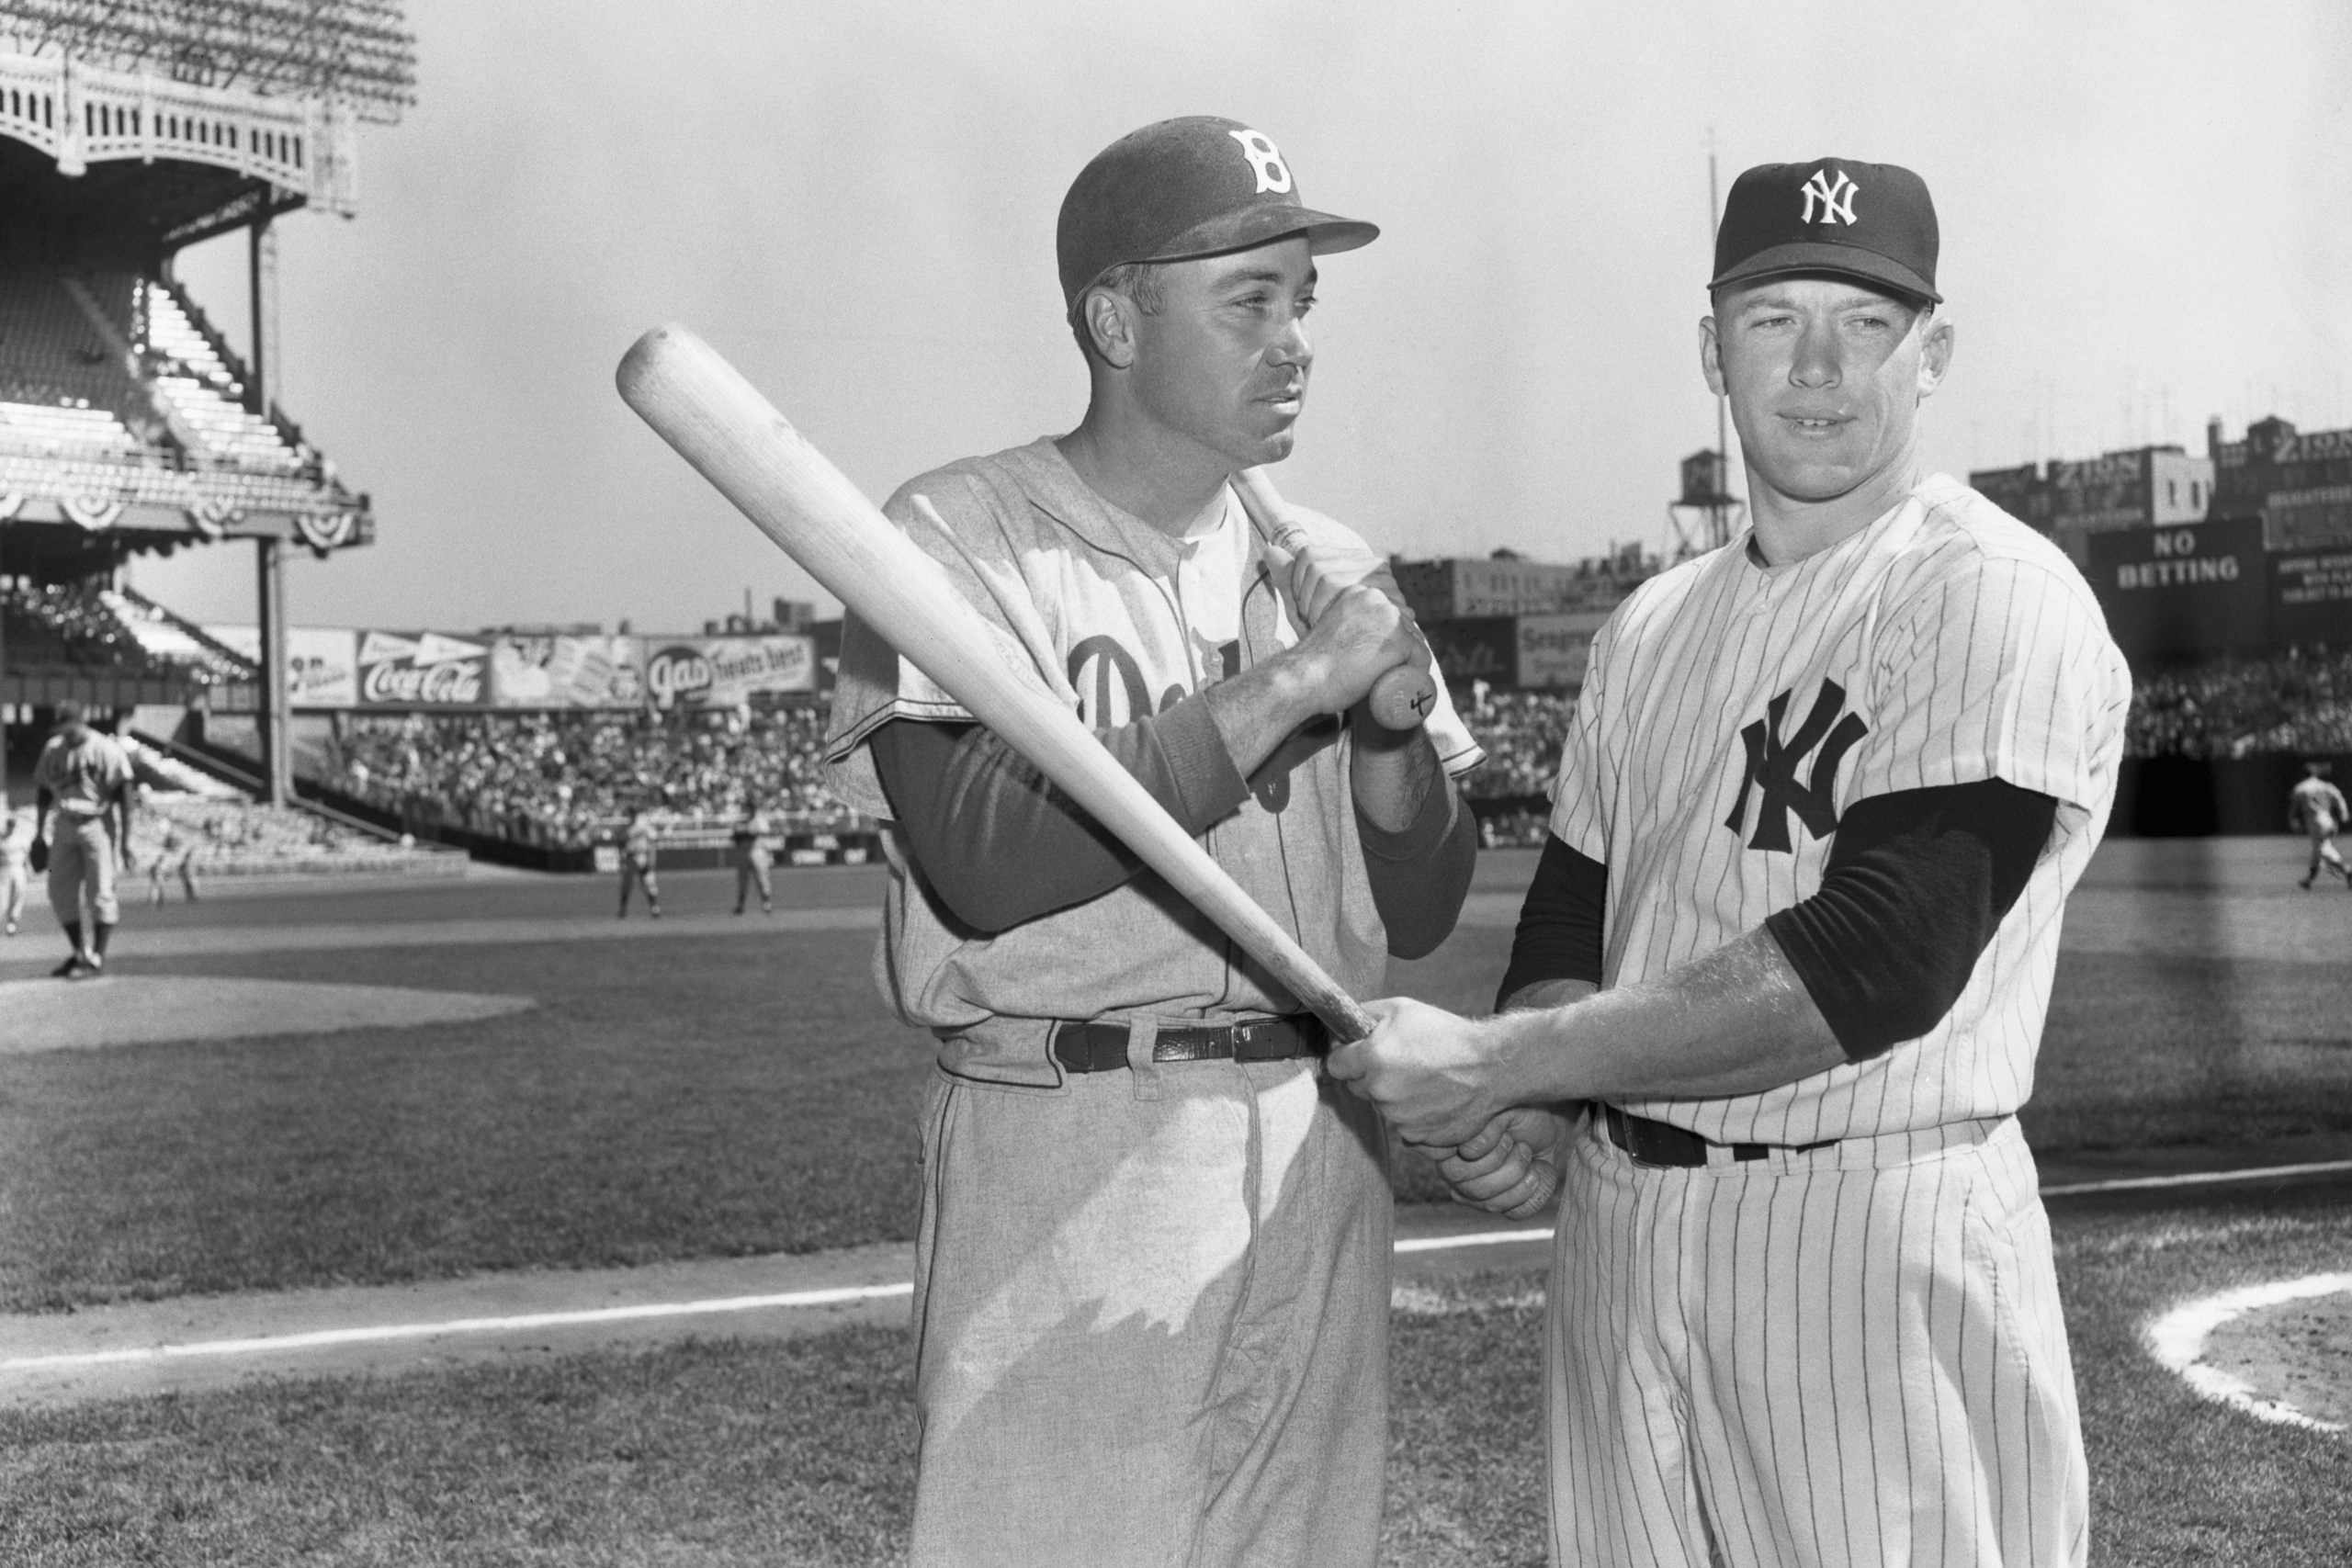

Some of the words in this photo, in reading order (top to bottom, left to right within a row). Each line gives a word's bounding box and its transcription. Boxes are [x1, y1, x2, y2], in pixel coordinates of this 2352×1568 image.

[1228, 130, 1291, 194] B
[1801, 168, 1860, 226] NY
[2154, 530, 2196, 557] NO
[2117, 555, 2239, 589] BETTING
[1410, 690, 1432, 716] 4
[1724, 676, 1869, 854] NY
